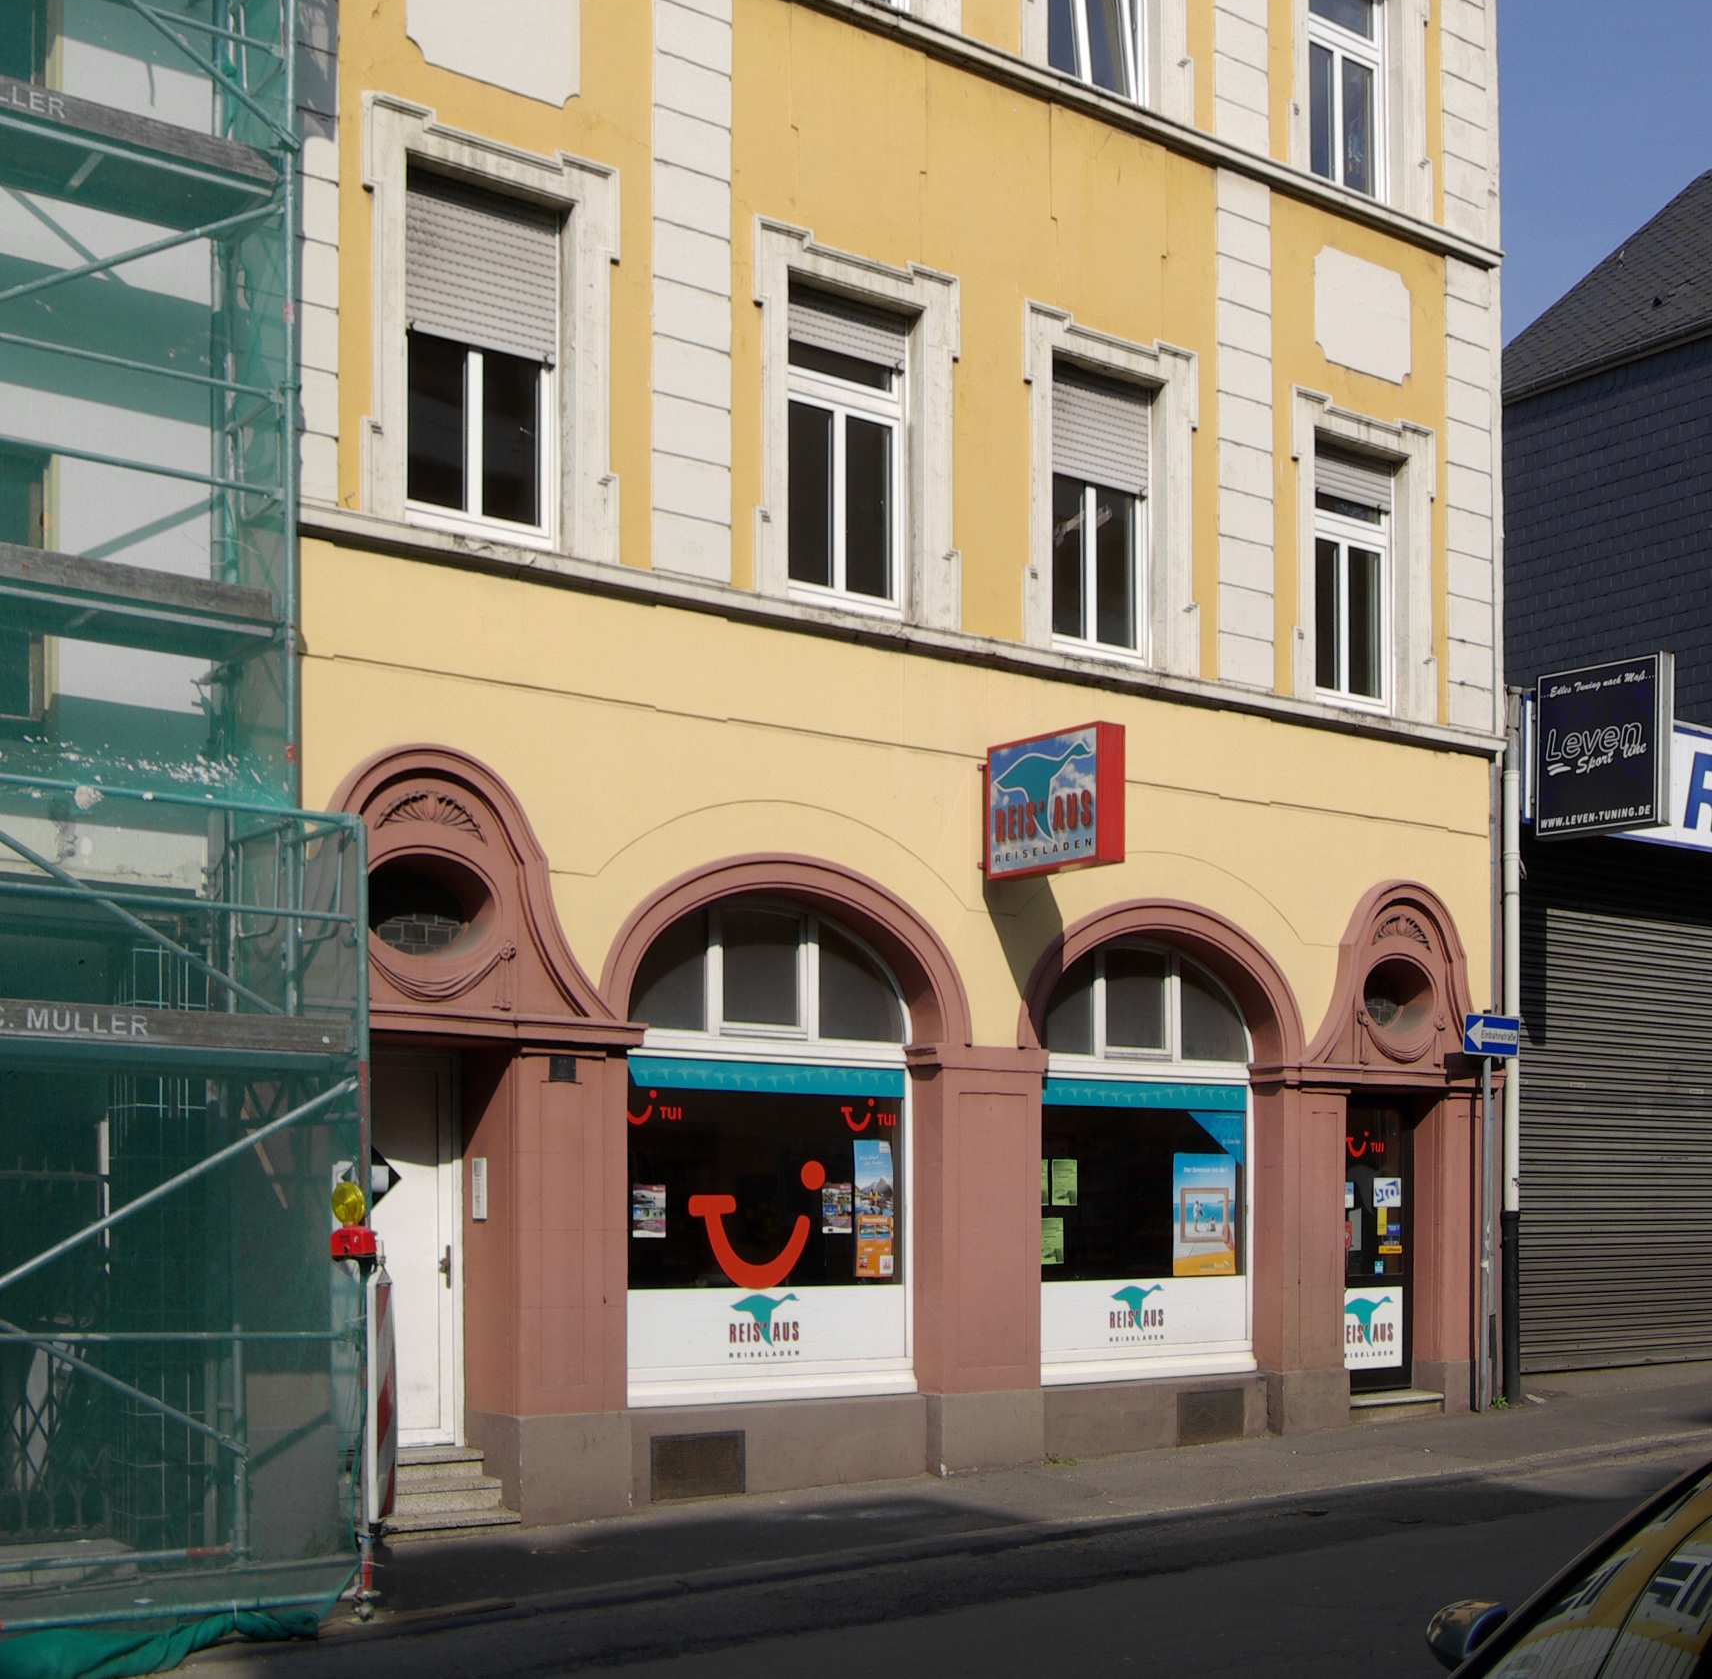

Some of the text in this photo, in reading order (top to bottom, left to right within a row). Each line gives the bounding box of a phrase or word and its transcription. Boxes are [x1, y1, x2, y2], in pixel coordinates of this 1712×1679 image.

[1574, 681, 1601, 692] Tuning
[1602, 674, 1622, 687] nach
[1546, 722, 1642, 762] Leven
[1575, 749, 1614, 774] Sport
[1540, 804, 1652, 829] WWW.LEVEN-TUNING.DE
[995, 837, 1093, 864] REISELADEN
[1481, 1029, 1516, 1042] Einbahnstraße
[659, 1106, 682, 1120] TUI
[876, 1113, 897, 1126] TUI
[1370, 1142, 1385, 1153] TUI
[1109, 1334, 1164, 1342] REISELADEN
[729, 1350, 800, 1359] REISELADEN
[1344, 1350, 1394, 1359] EISELADEN
